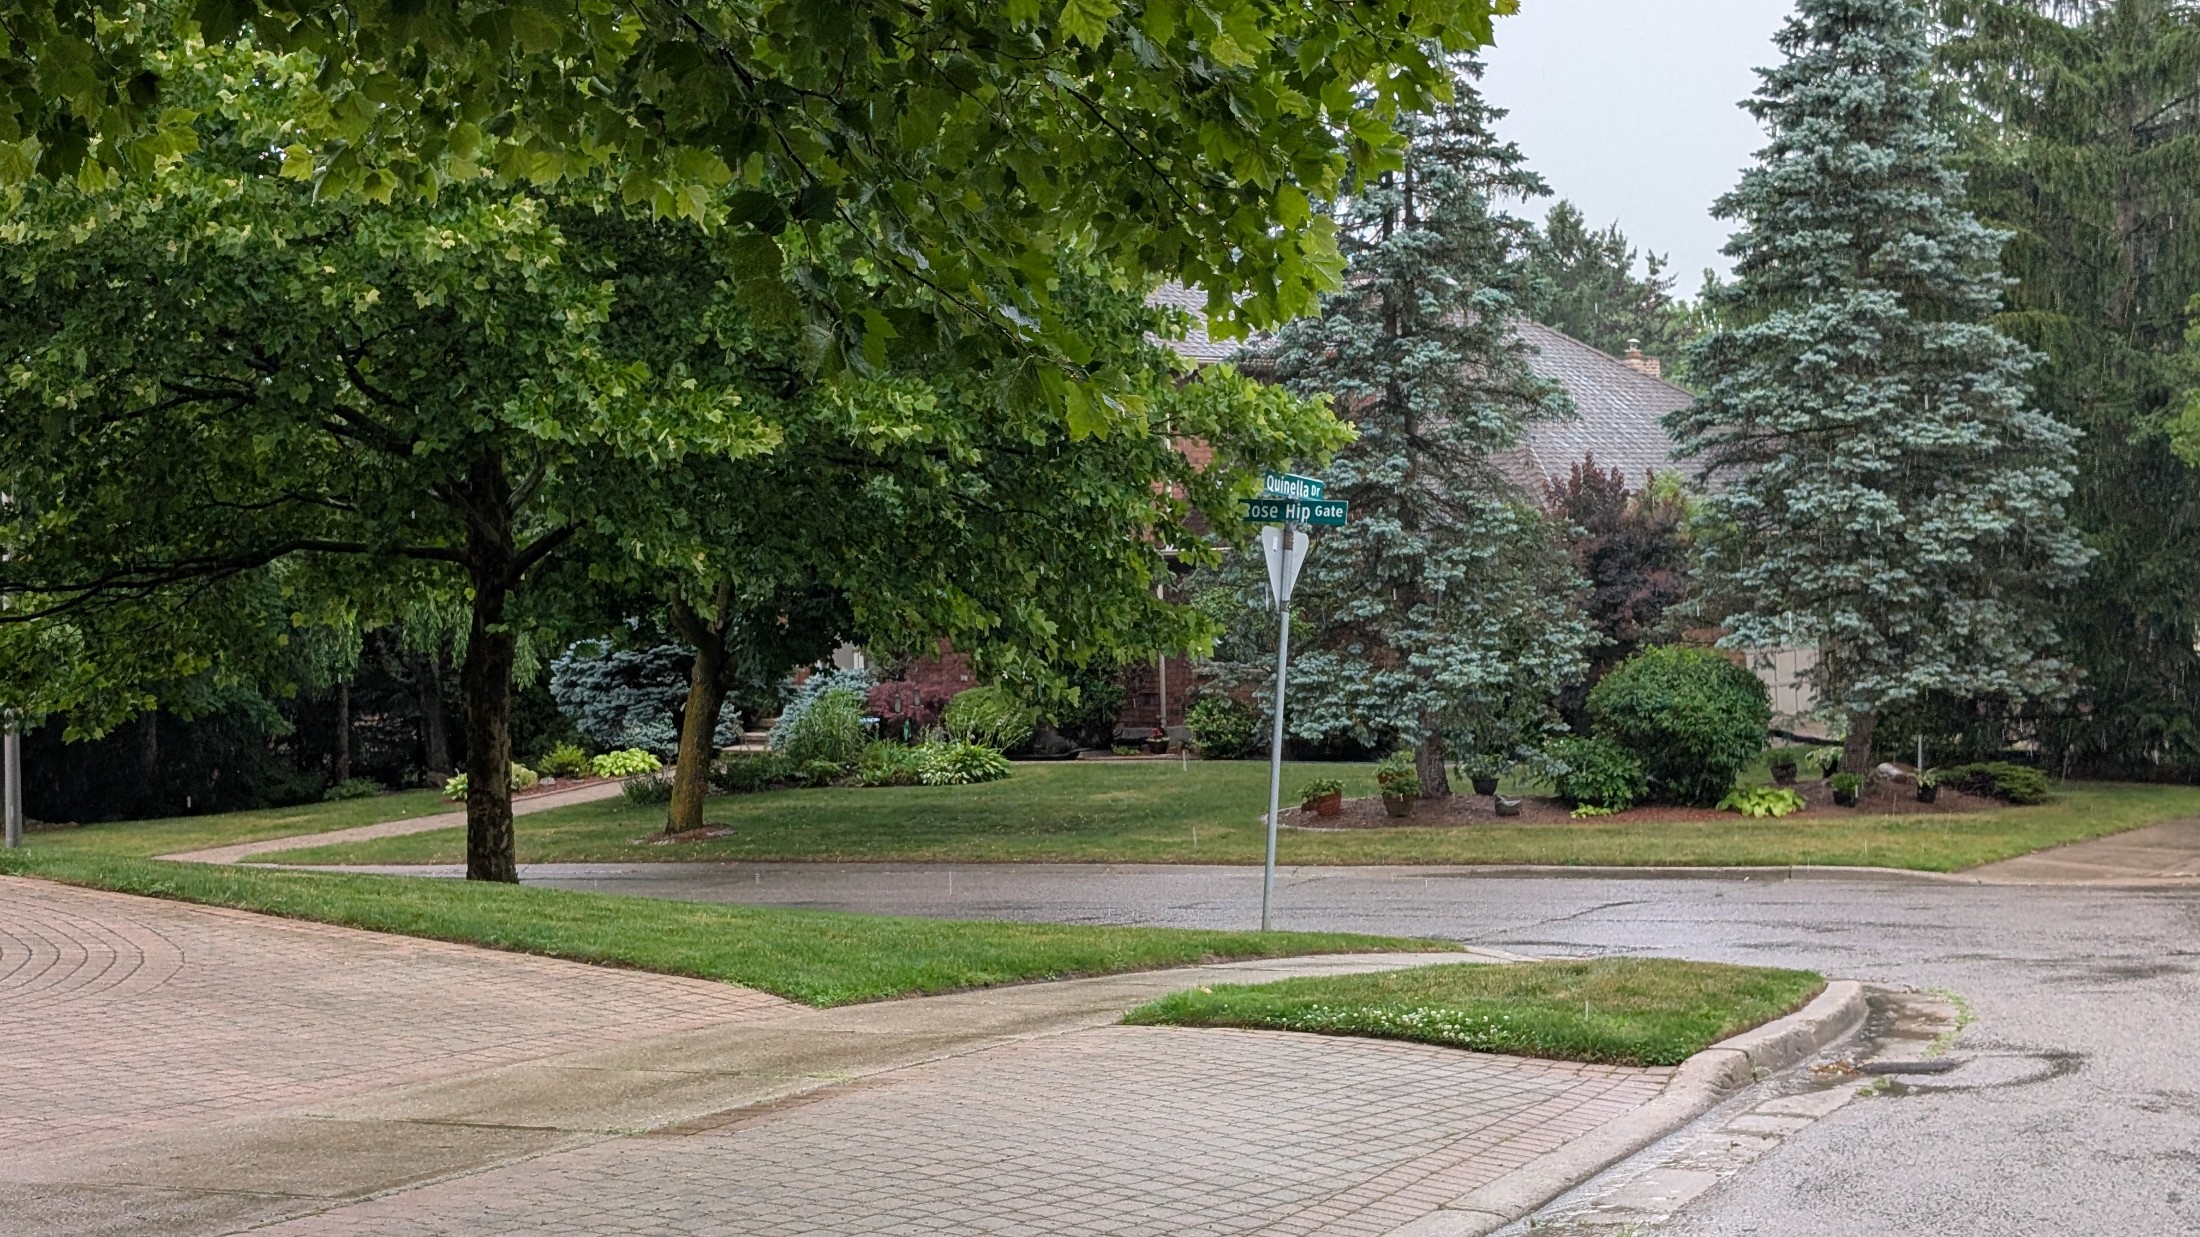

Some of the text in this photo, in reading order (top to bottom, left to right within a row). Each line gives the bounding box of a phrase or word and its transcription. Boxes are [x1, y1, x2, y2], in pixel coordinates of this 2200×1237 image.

[1266, 475, 1320, 497] Quinella Dr
[1286, 503, 1310, 523] Hip
[1315, 505, 1343, 517] Gate
